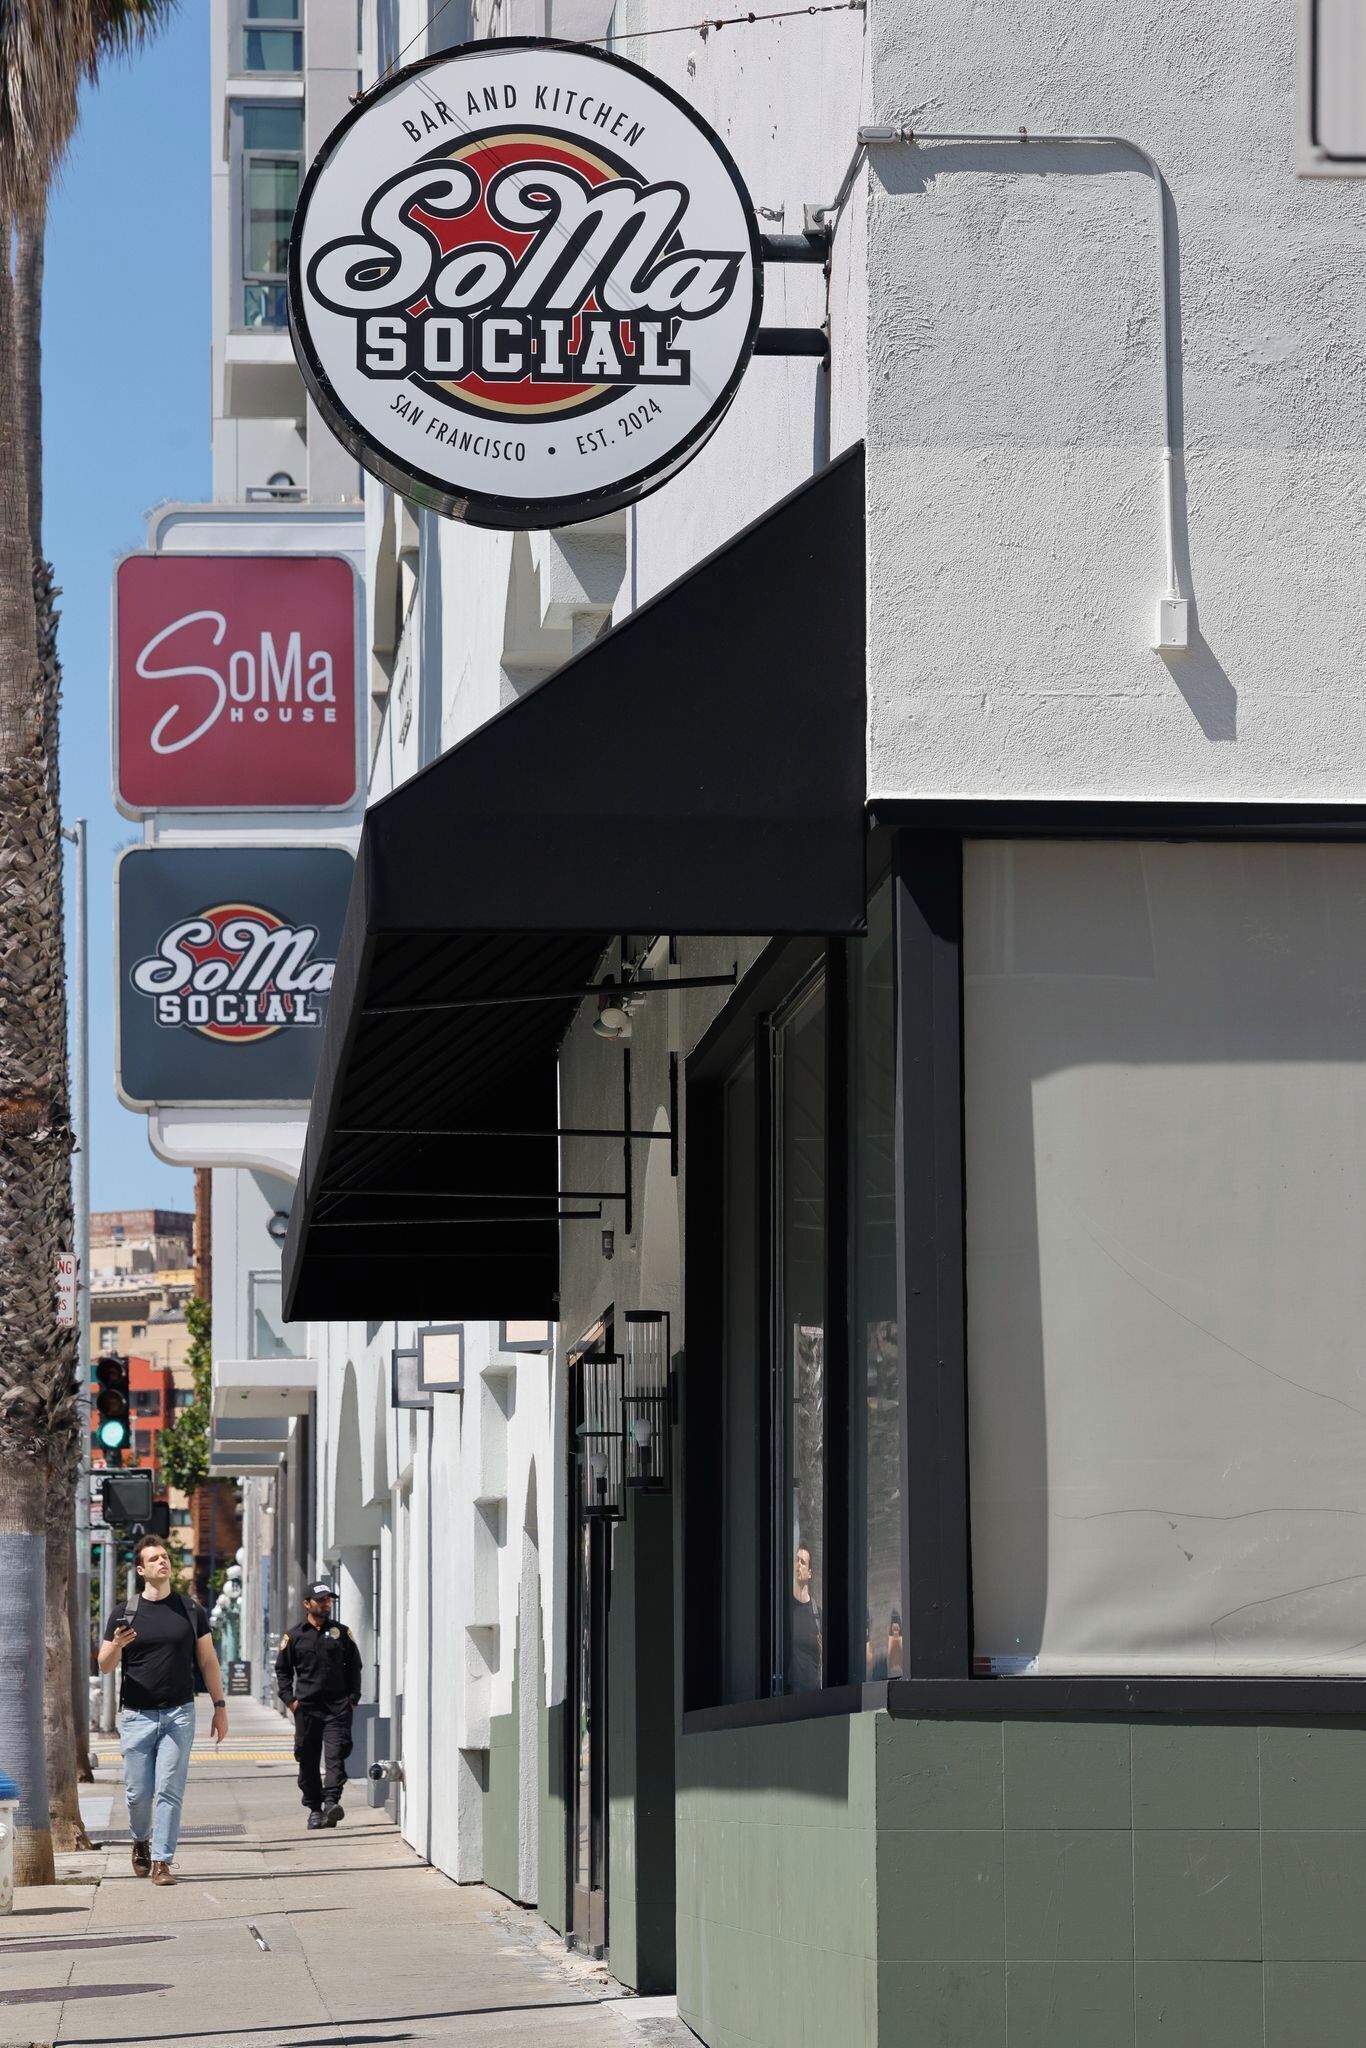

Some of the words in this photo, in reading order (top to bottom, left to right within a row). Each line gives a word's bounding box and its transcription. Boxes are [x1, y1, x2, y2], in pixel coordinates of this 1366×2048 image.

[402, 101, 454, 143] BAR
[467, 84, 517, 116] AND
[535, 85, 646, 147] KITCHEN
[307, 159, 746, 320] SoMa
[359, 314, 690, 383] SOCIAL
[390, 394, 424, 426] SAN
[427, 420, 526, 462] FRANCISCO
[577, 430, 615, 455] EST.
[618, 398, 662, 437] 2024
[136, 610, 336, 754] SoMa
[230, 707, 337, 723] HOUSE
[131, 917, 336, 996] SoMa
[157, 993, 319, 1024] SOCIAL
